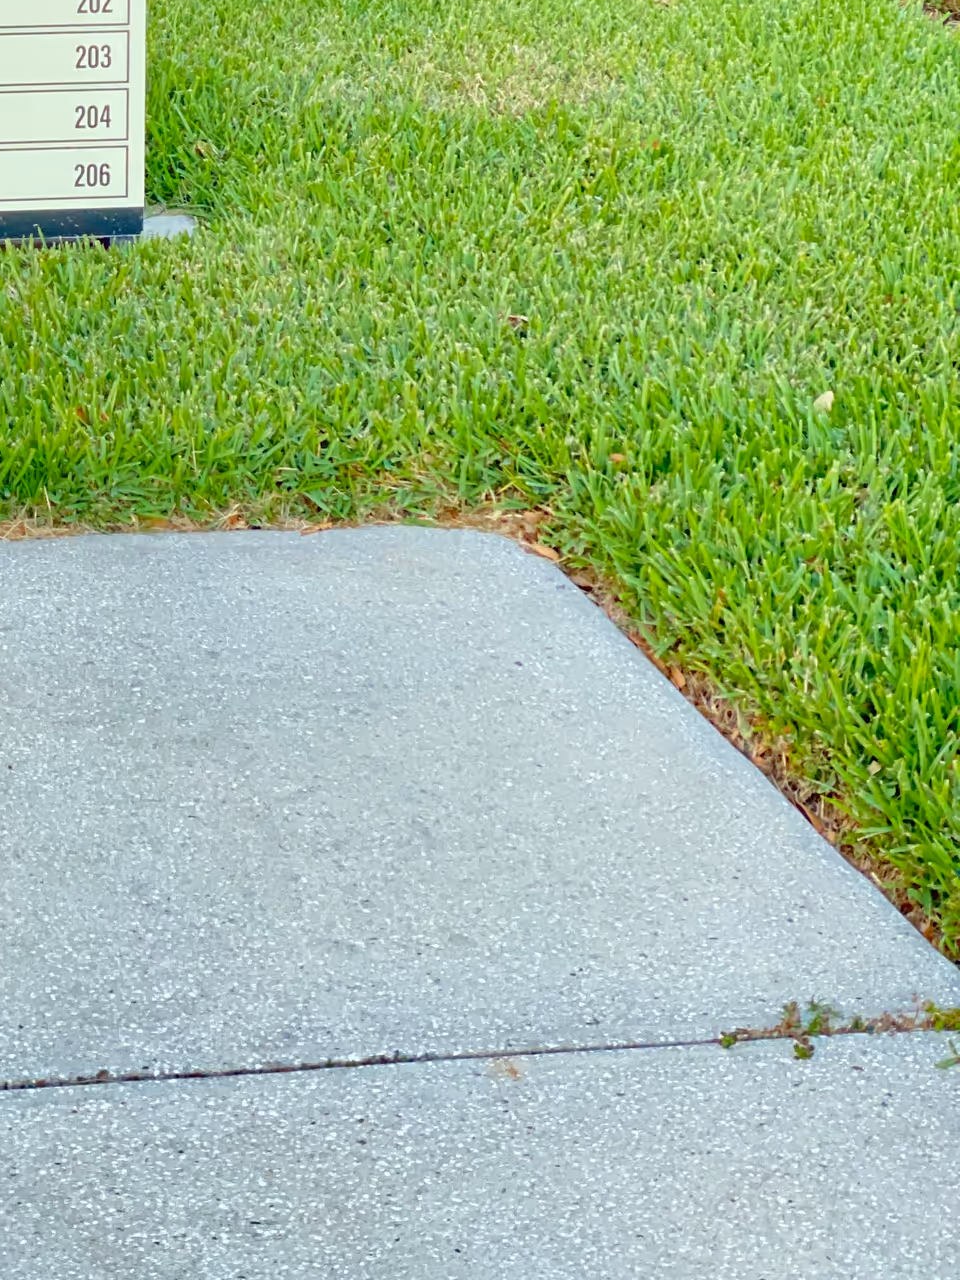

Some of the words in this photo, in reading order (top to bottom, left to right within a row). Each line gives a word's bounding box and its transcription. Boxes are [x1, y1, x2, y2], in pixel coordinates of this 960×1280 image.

[75, 45, 112, 69] 203
[74, 105, 112, 129] 204
[74, 163, 111, 187] 206
